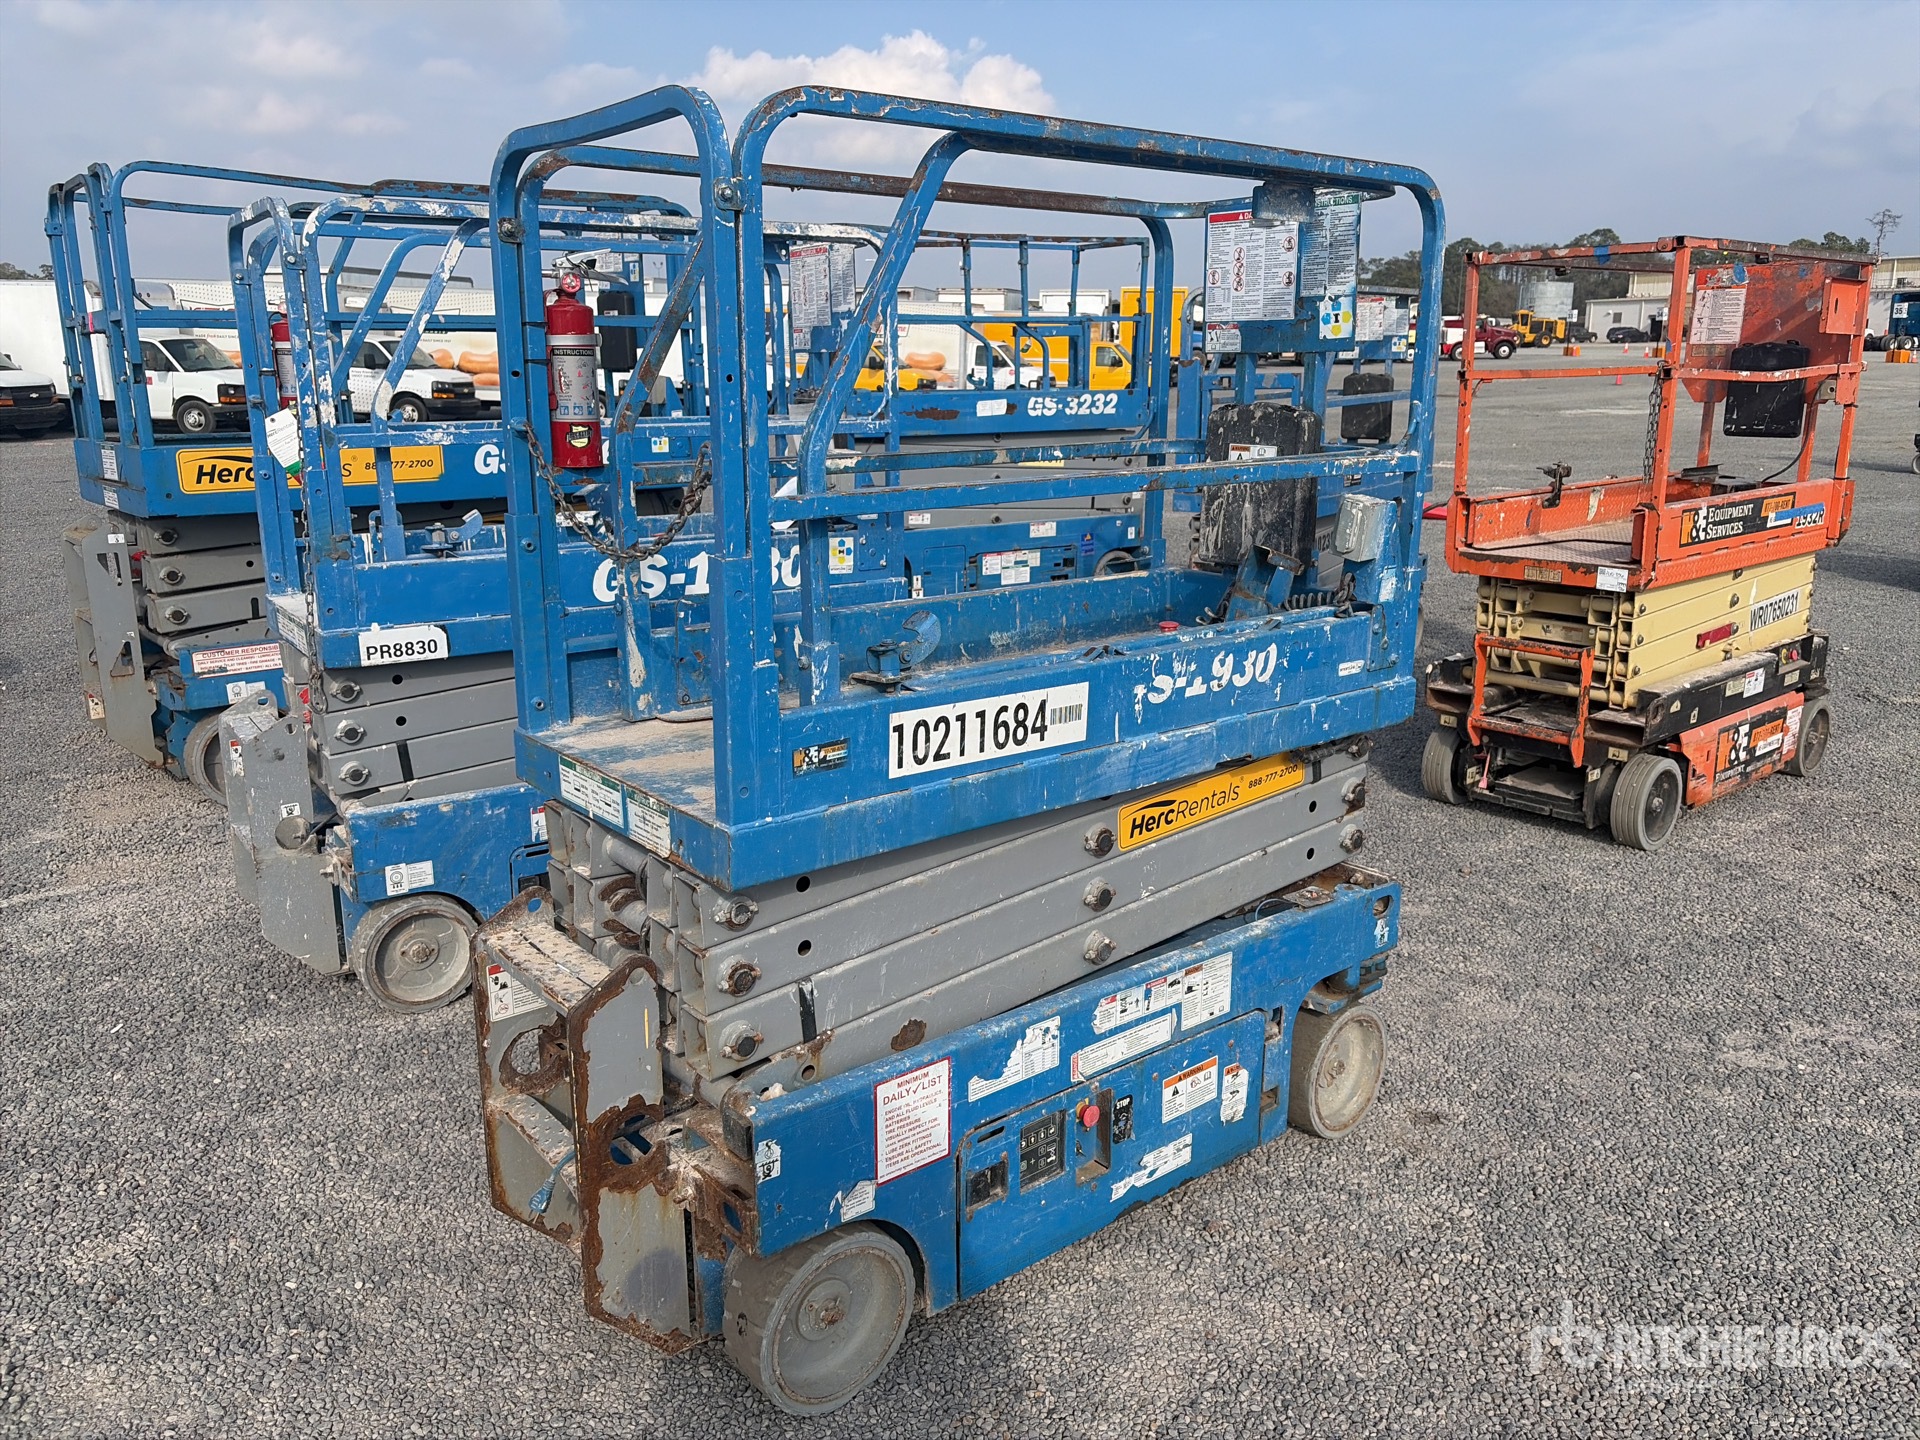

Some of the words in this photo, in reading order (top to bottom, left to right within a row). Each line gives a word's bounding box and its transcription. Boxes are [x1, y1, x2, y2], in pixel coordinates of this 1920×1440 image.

[1027, 393, 1118, 416] GS-3232
[1708, 504, 1754, 522] EQUIPMENT
[1706, 521, 1744, 540] SERVICES
[1750, 591, 1799, 632] WR07650231
[202, 650, 239, 658] CUSTOMER
[366, 639, 438, 661] PR8830
[892, 699, 1048, 770] 10211684
[1129, 783, 1240, 839] HercRentals
[1248, 764, 1298, 789] 888-777-2700
[897, 1072, 929, 1088] MINIMUM
[1183, 1064, 1204, 1080] WARNING
[883, 1088, 911, 1105] DAILY
[1116, 1098, 1130, 1110] STOP
[885, 1115, 910, 1128] BATTERIES
[896, 1118, 920, 1130] PRESSURE
[885, 1130, 907, 1142] VISUALLY
